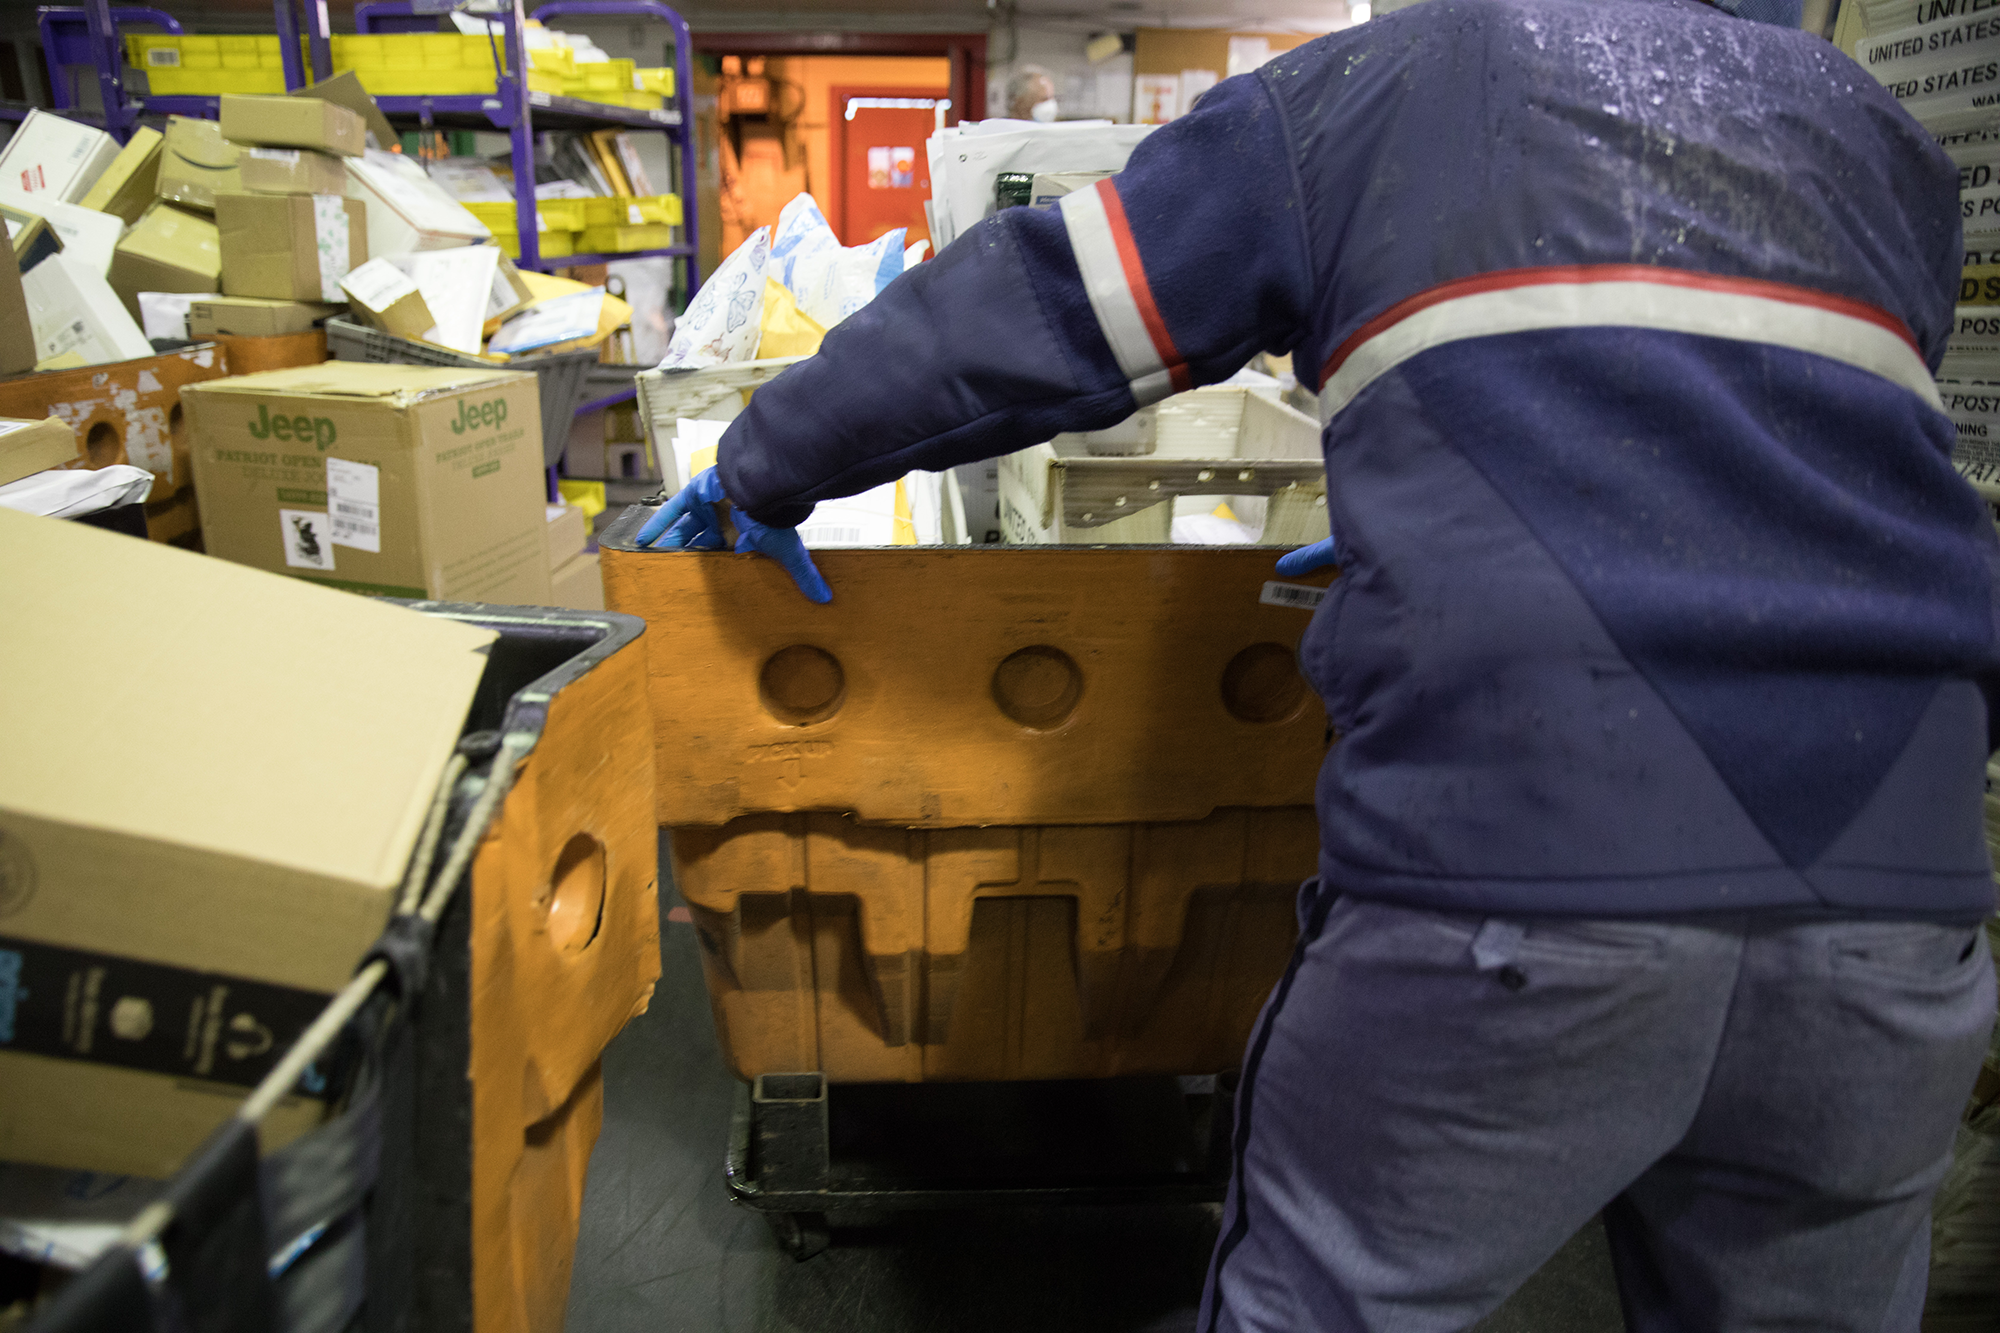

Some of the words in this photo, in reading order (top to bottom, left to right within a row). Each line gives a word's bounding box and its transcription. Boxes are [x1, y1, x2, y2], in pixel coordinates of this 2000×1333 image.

[1869, 37, 1924, 64] UNITED
[1929, 17, 2000, 51] STATES
[1923, 62, 1998, 93] STATES
[248, 404, 337, 451] Jeep
[450, 397, 508, 435] Jeep
[1954, 423, 1988, 438] NING
[214, 449, 278, 466] PATRIOT
[281, 453, 322, 468] OPEN
[746, 740, 801, 763] PICK
